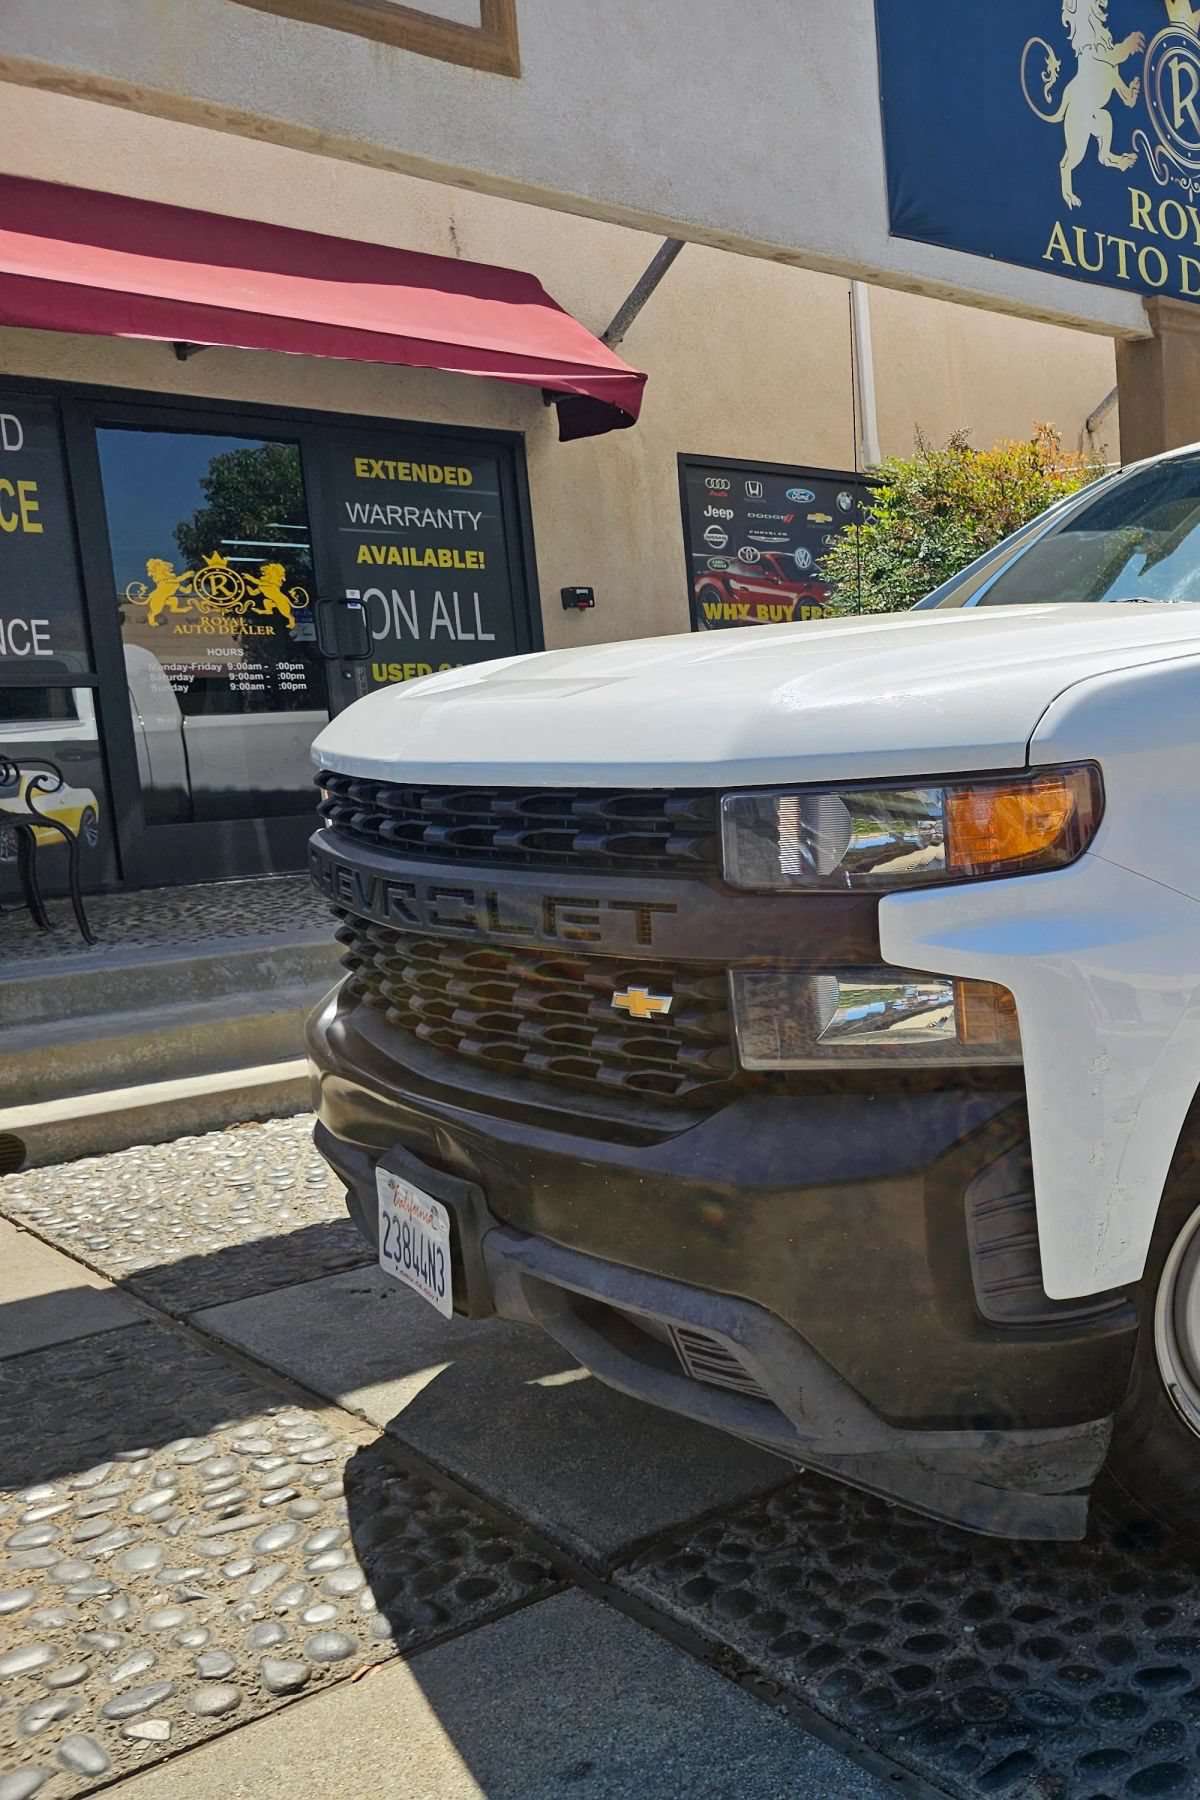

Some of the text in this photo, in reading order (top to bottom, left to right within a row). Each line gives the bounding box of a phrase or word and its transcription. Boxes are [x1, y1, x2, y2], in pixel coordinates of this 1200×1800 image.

[1043, 221, 1168, 287] AUTO
[354, 457, 473, 487] EXTENDED
[791, 490, 810, 501] Ford
[345, 501, 483, 531] WARRANTY
[703, 505, 734, 520] Jeep
[356, 544, 486, 570] AVAILABLE!
[209, 574, 233, 597] R
[200, 617, 248, 626] ROYAL
[362, 587, 496, 641] ON ALL
[702, 603, 750, 620] WHY
[757, 604, 795, 622] BUY
[173, 626, 276, 635] AUTO DEALER
[207, 648, 244, 656] HOURS
[148, 661, 222, 673] Monday-Friday
[227, 661, 262, 671] 9:00am
[372, 663, 433, 682] USED
[149, 673, 195, 683] Saturday
[228, 672, 264, 681] 9:00am
[150, 684, 190, 694] Sunday
[229, 682, 266, 691] 9:00am
[391, 1183, 438, 1231] California
[382, 1210, 445, 1298] 23844N3
